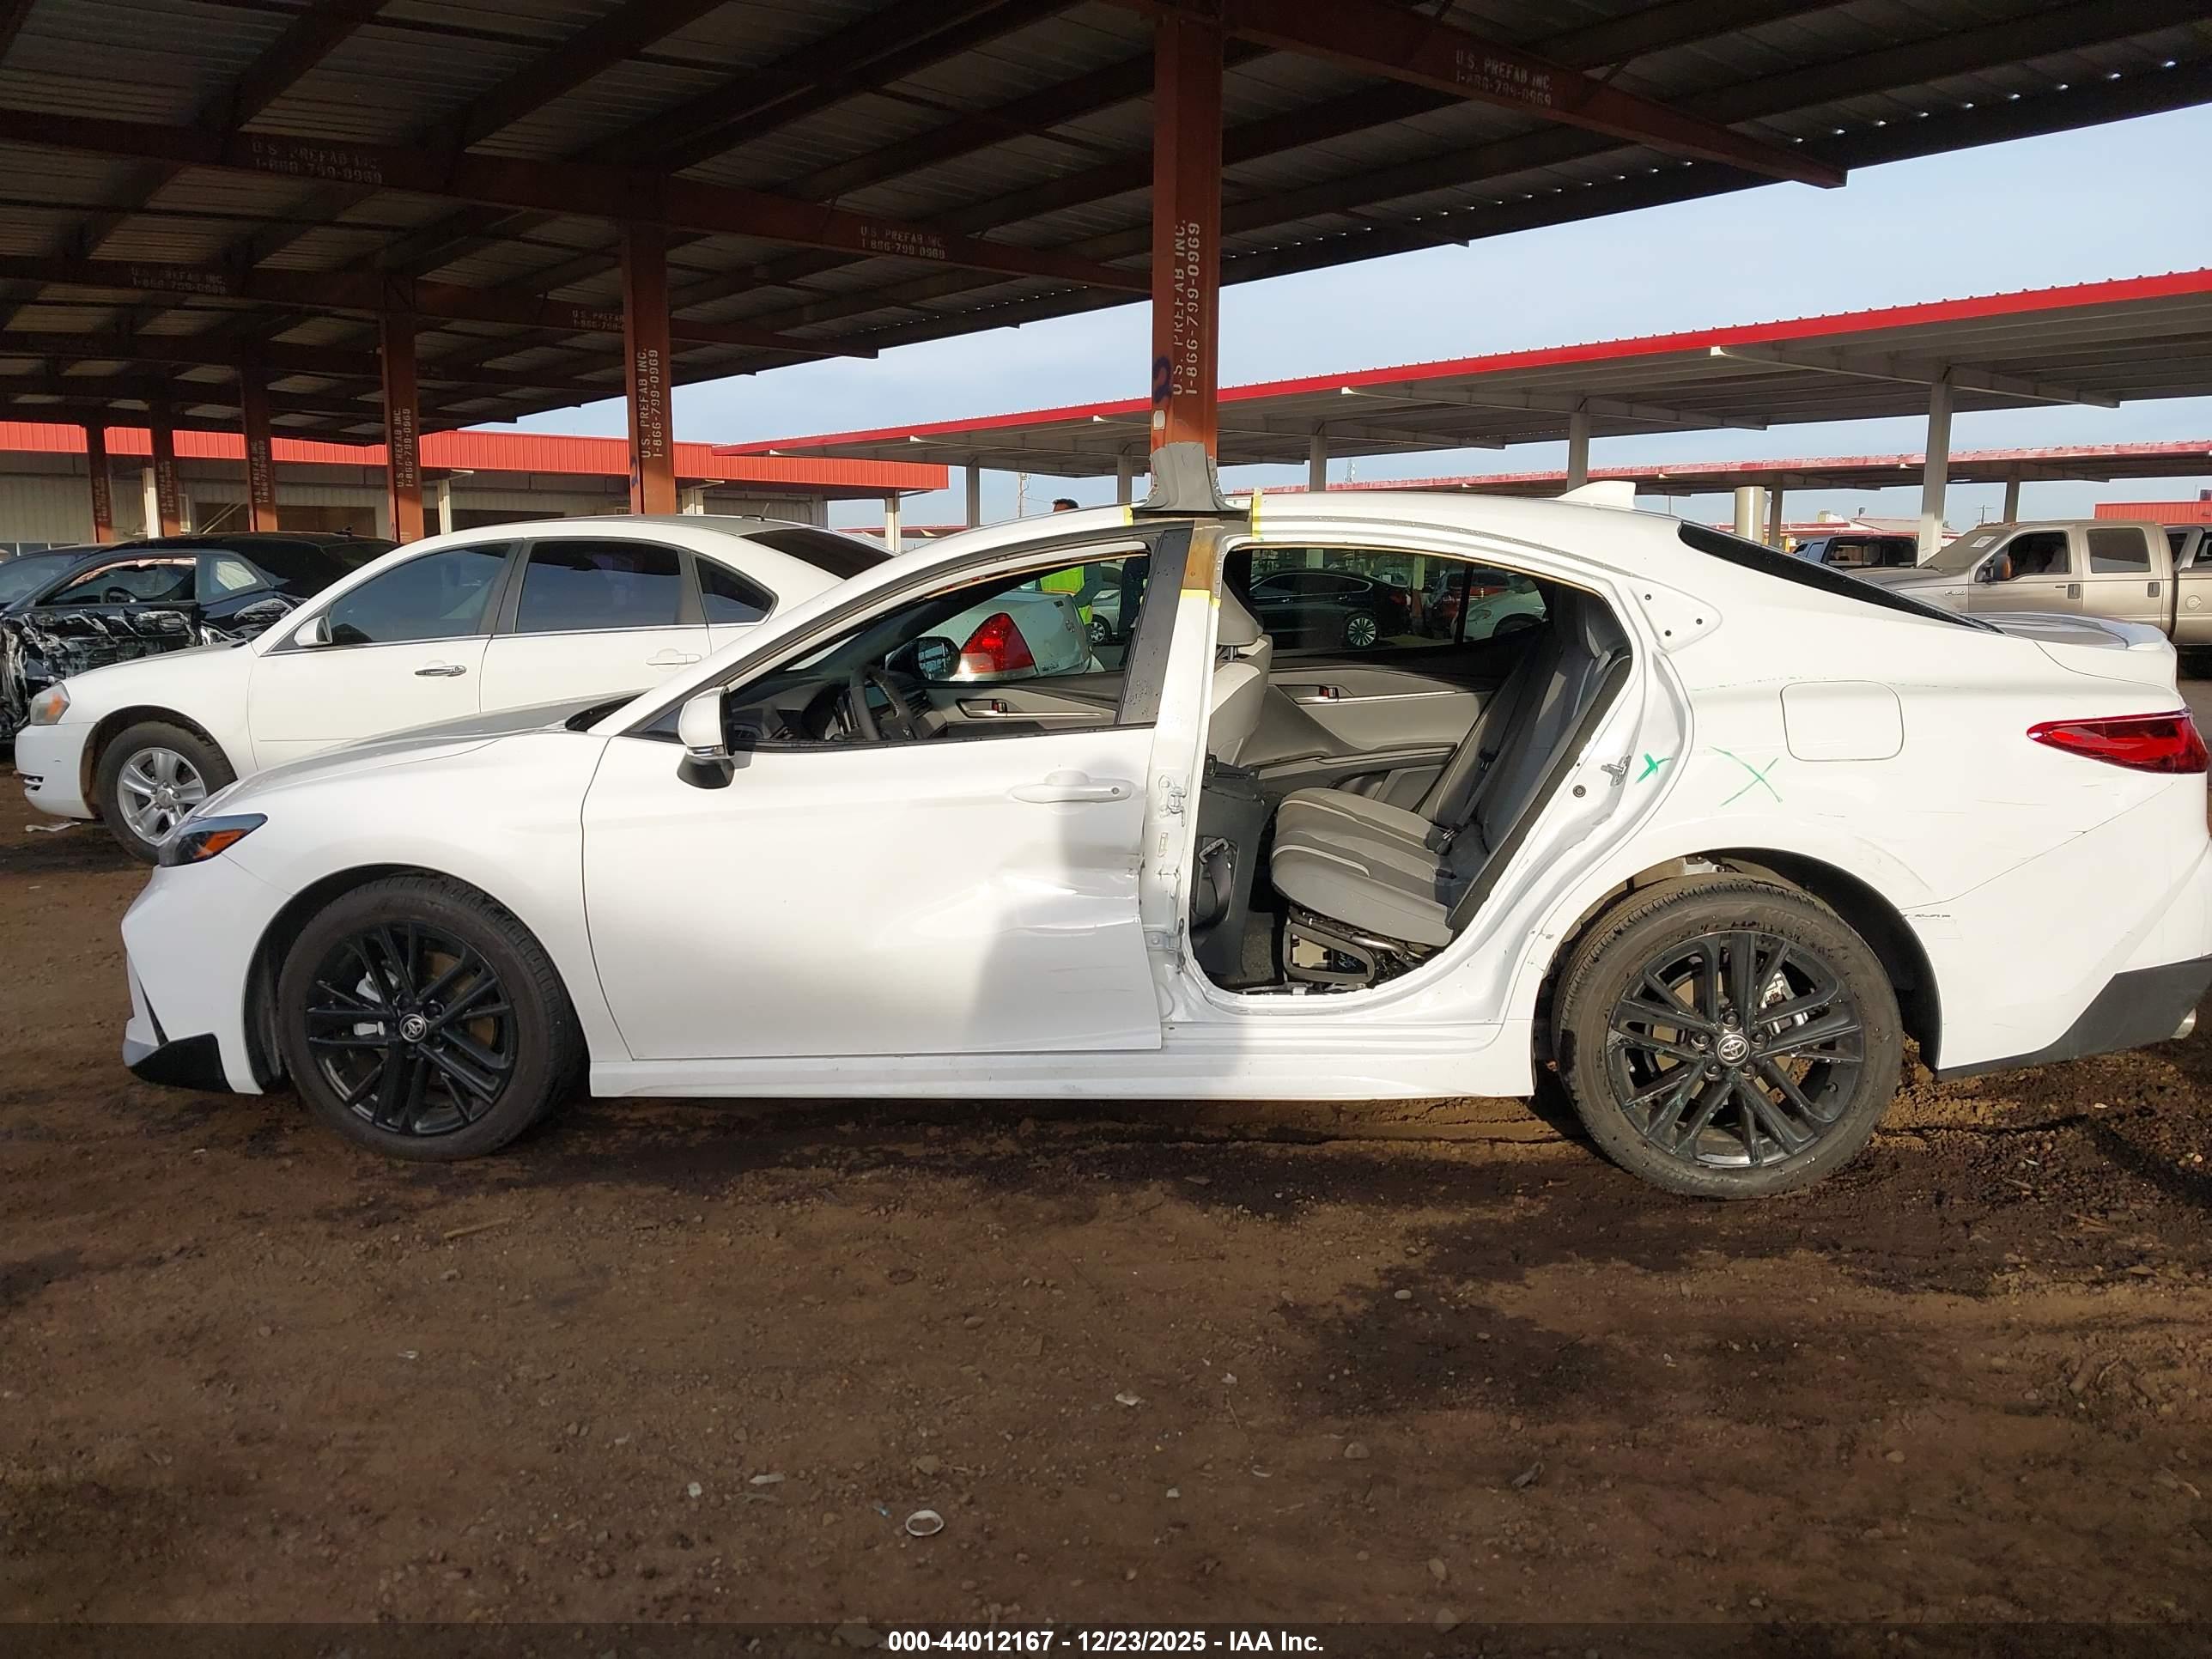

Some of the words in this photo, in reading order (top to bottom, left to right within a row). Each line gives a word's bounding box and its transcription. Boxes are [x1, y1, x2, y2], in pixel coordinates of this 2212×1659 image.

[1484, 59, 1528, 83] PREFAB
[885, 229, 923, 244] PREFAB
[1175, 219, 1186, 257] INC.
[1174, 268, 1184, 346] PREFAB
[1186, 222, 1200, 395] 1-866-799-0969
[637, 348, 647, 372] INC.
[1173, 358, 1183, 395] U.S.
[638, 379, 649, 427] PREFAB
[648, 349, 663, 457] 1-866-799-0969
[394, 429, 404, 465] PREFAB
[641, 434, 651, 458] U.S.
